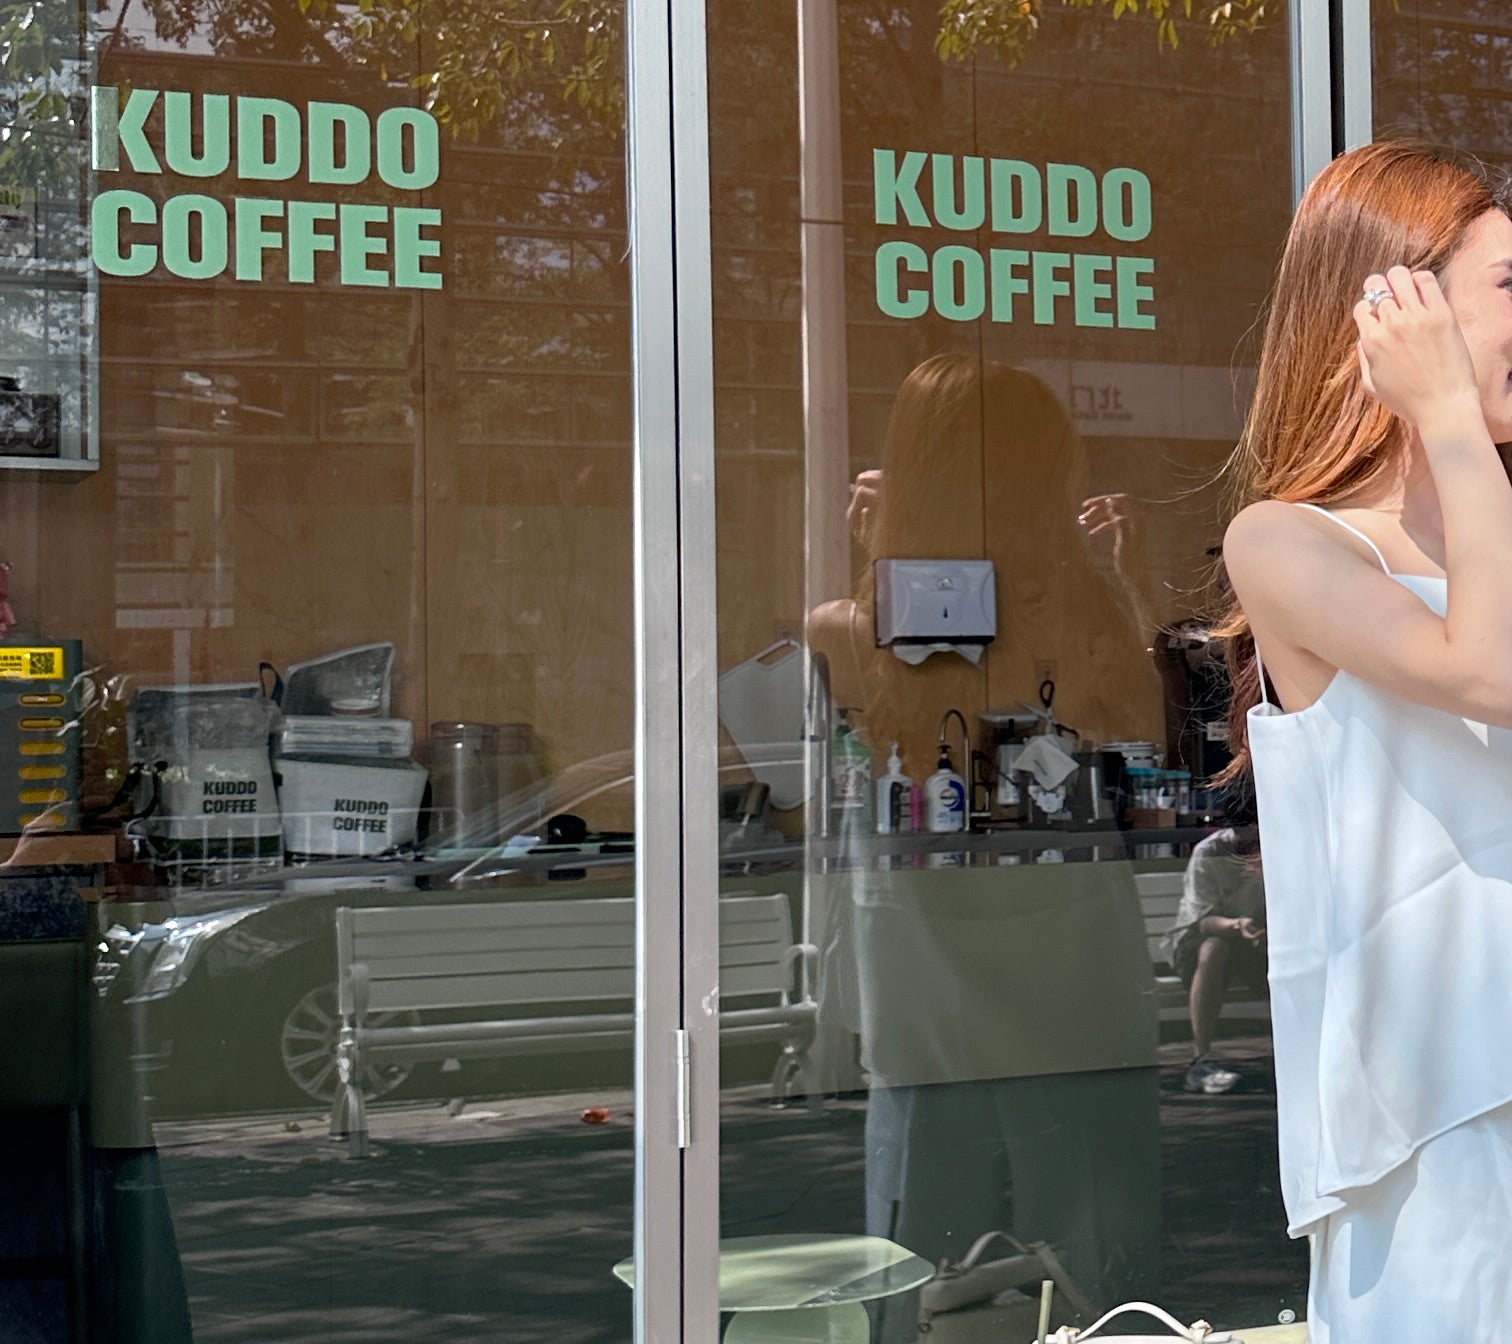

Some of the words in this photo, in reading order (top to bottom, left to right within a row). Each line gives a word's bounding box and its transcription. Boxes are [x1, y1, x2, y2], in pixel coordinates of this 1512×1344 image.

[90, 85, 441, 190] KUDDO
[873, 148, 1152, 242] KUDDO
[90, 188, 443, 290] COFFEE
[875, 241, 1156, 330] COFFEE
[203, 781, 257, 795] KUDDO
[203, 799, 257, 814] COFFEE
[334, 798, 389, 816] KUDDO
[333, 816, 387, 833] COFFEE
